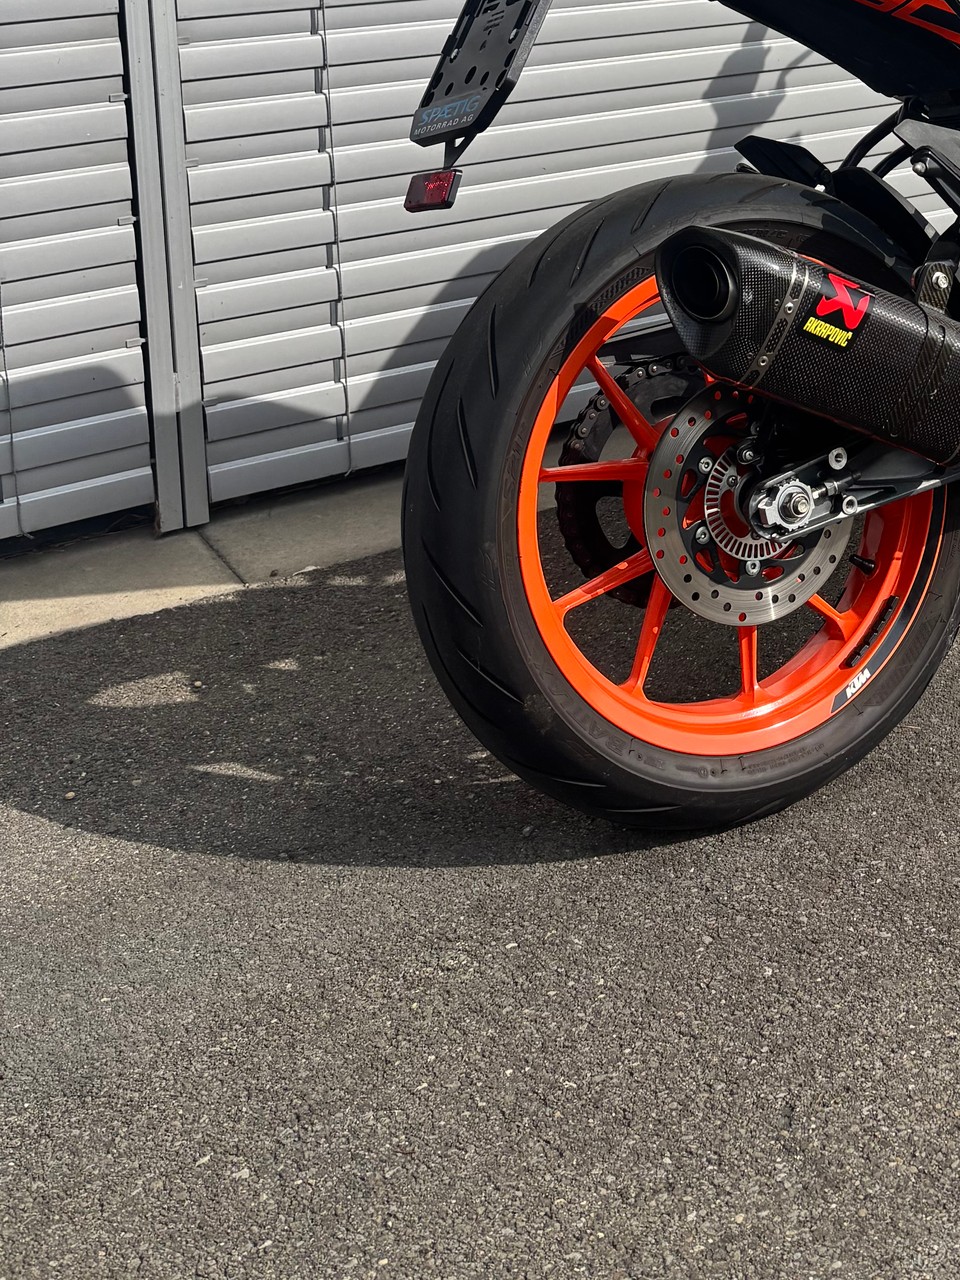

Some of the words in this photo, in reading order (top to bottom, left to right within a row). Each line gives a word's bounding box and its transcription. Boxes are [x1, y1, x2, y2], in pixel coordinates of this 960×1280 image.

[414, 118, 460, 136] MOTORRAD
[460, 113, 474, 124] AG
[845, 667, 871, 699] KTM
